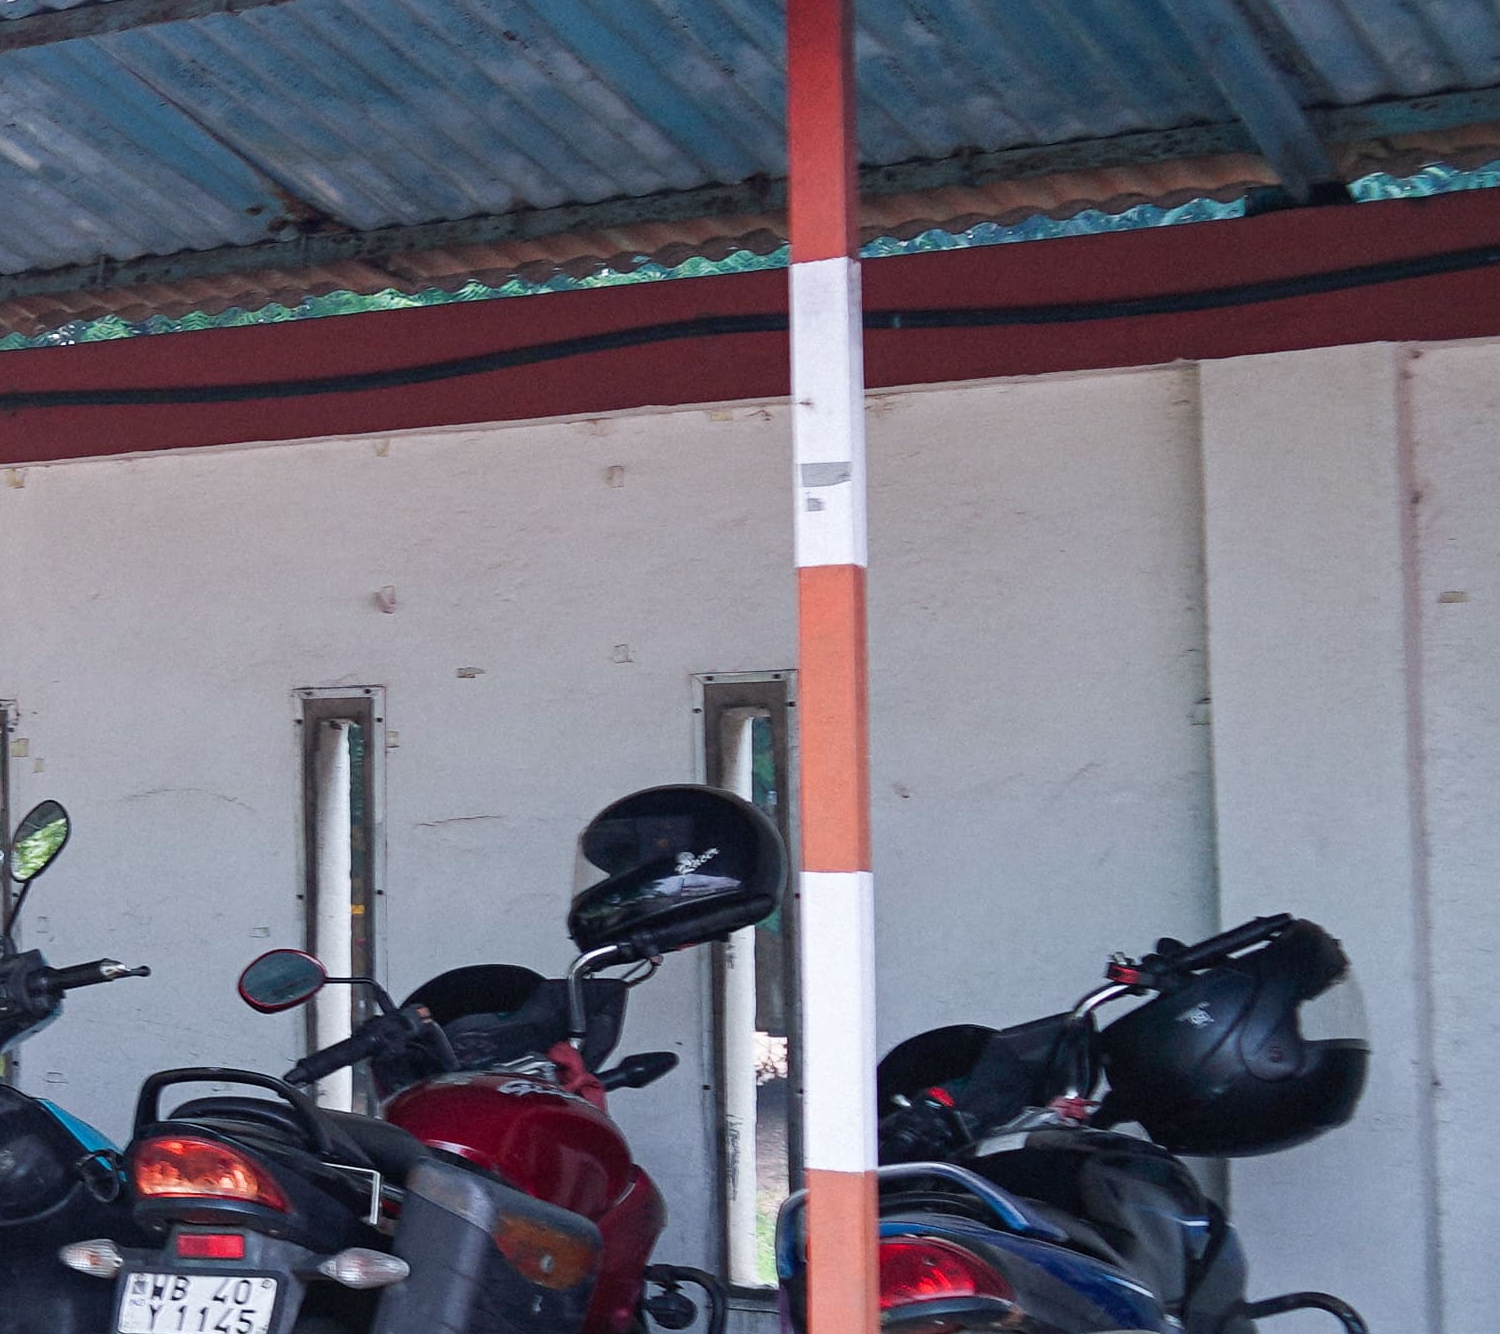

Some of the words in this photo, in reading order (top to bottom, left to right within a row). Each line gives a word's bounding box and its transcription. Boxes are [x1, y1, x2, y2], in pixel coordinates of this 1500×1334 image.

[150, 1273, 191, 1302] WB
[211, 1278, 253, 1305] 40
[149, 1303, 257, 1334] Y1145
